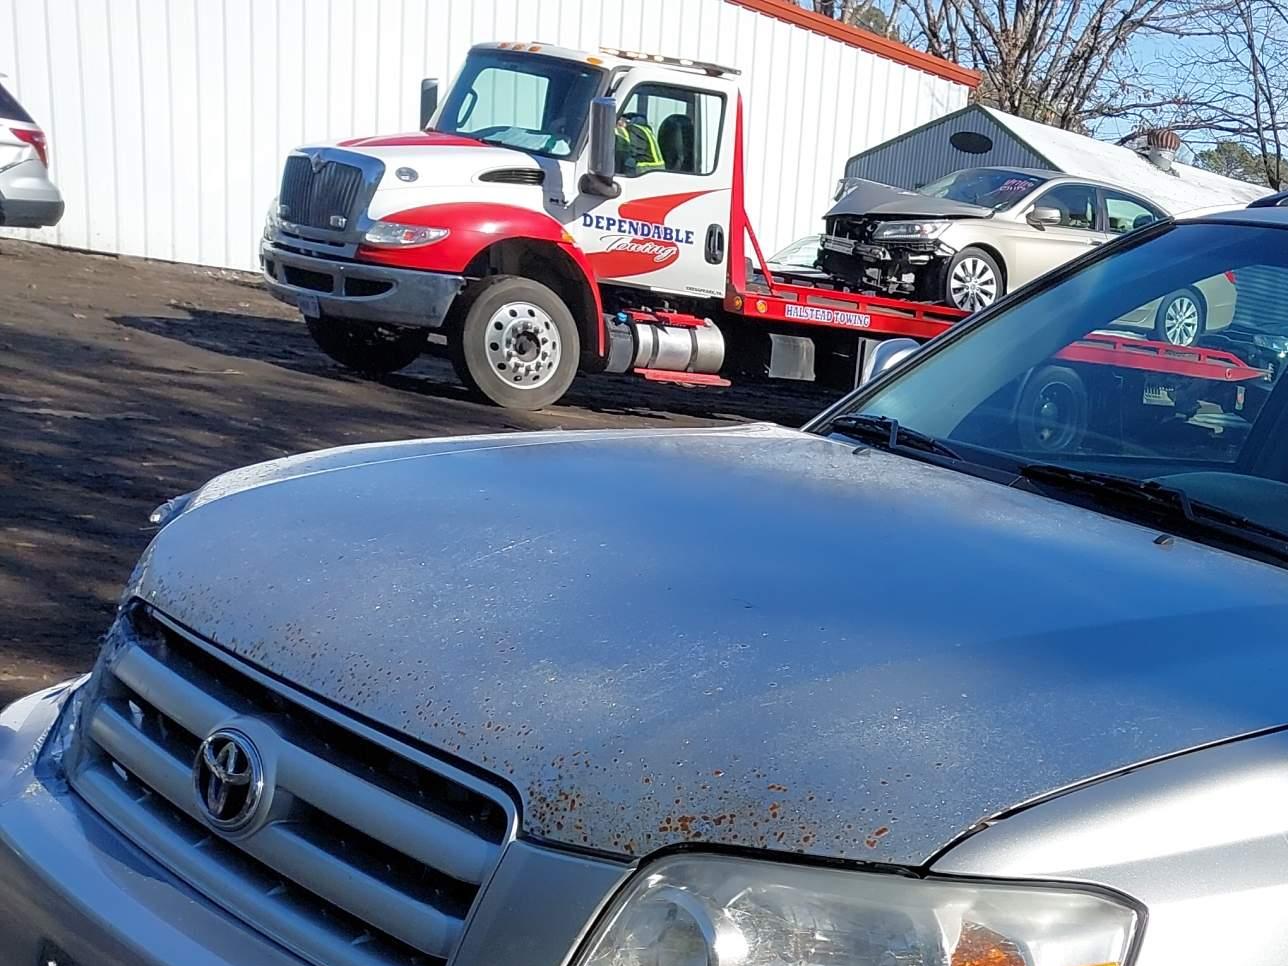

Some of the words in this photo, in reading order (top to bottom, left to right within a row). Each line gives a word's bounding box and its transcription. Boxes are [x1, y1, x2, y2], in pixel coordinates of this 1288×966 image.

[582, 213, 695, 245] DEPENDABLE
[599, 234, 677, 262] Towing
[785, 304, 833, 322] HALSTEAD
[834, 311, 871, 327] TOWING
